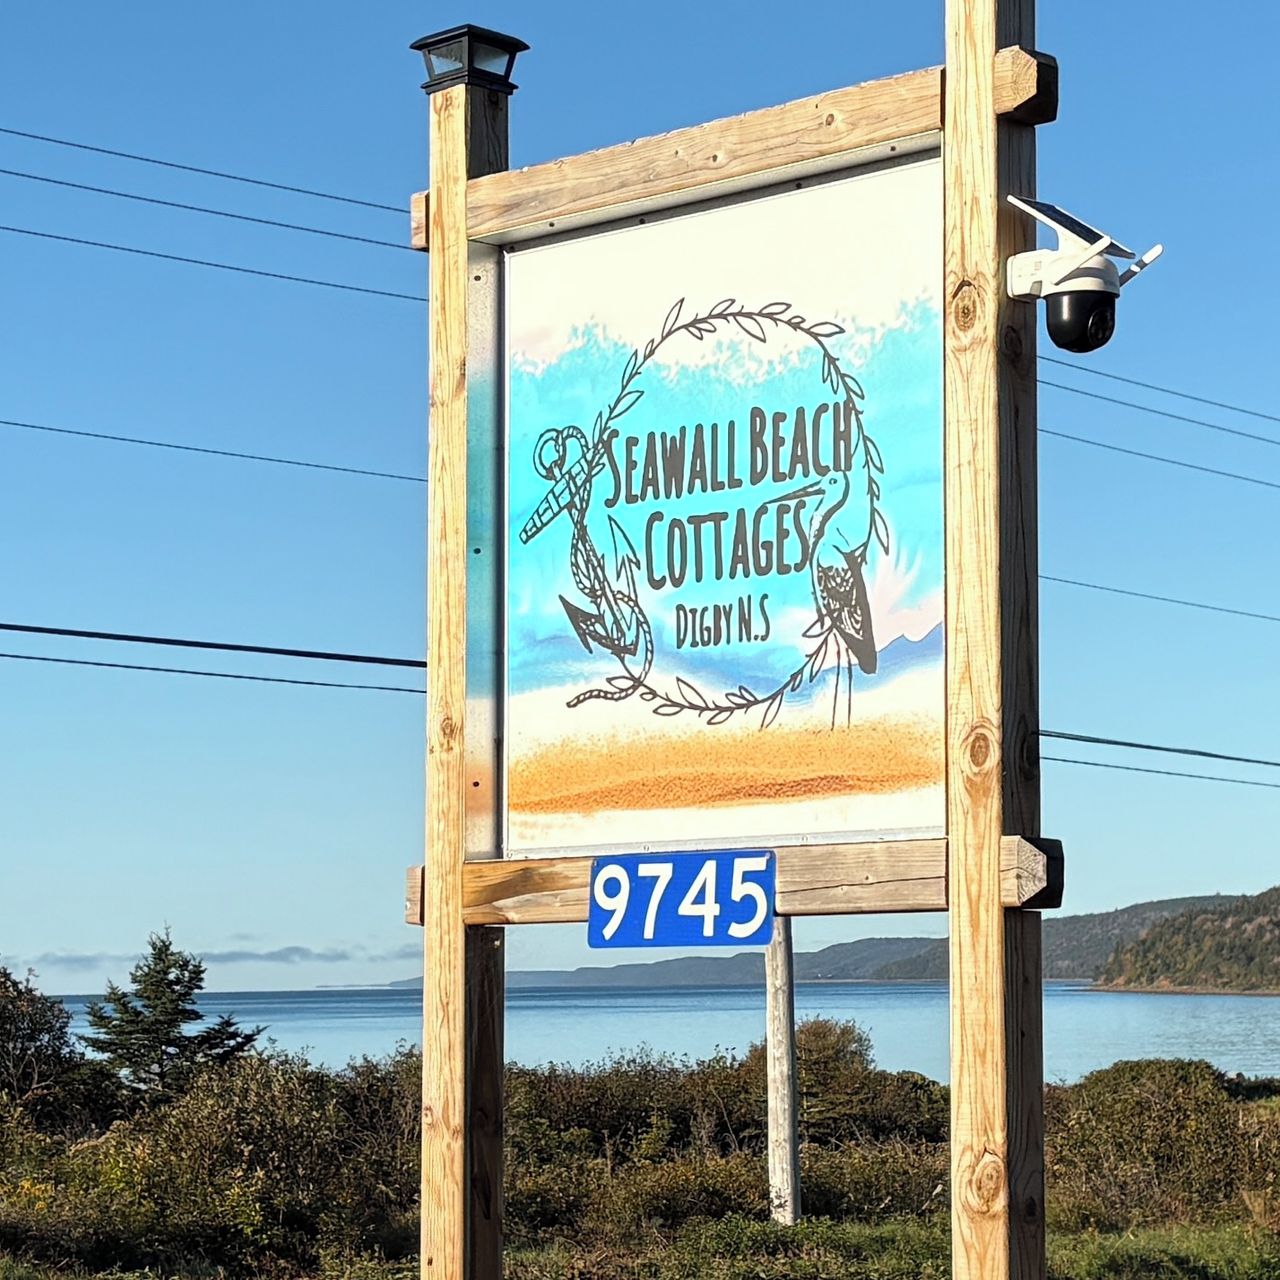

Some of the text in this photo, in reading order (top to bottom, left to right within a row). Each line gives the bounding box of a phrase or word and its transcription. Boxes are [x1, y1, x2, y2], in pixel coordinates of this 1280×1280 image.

[605, 400, 854, 508] SEAWALL BEACH
[645, 499, 811, 590] COTTAGES
[676, 603, 733, 649] DIGBY
[593, 857, 768, 941] 9745
